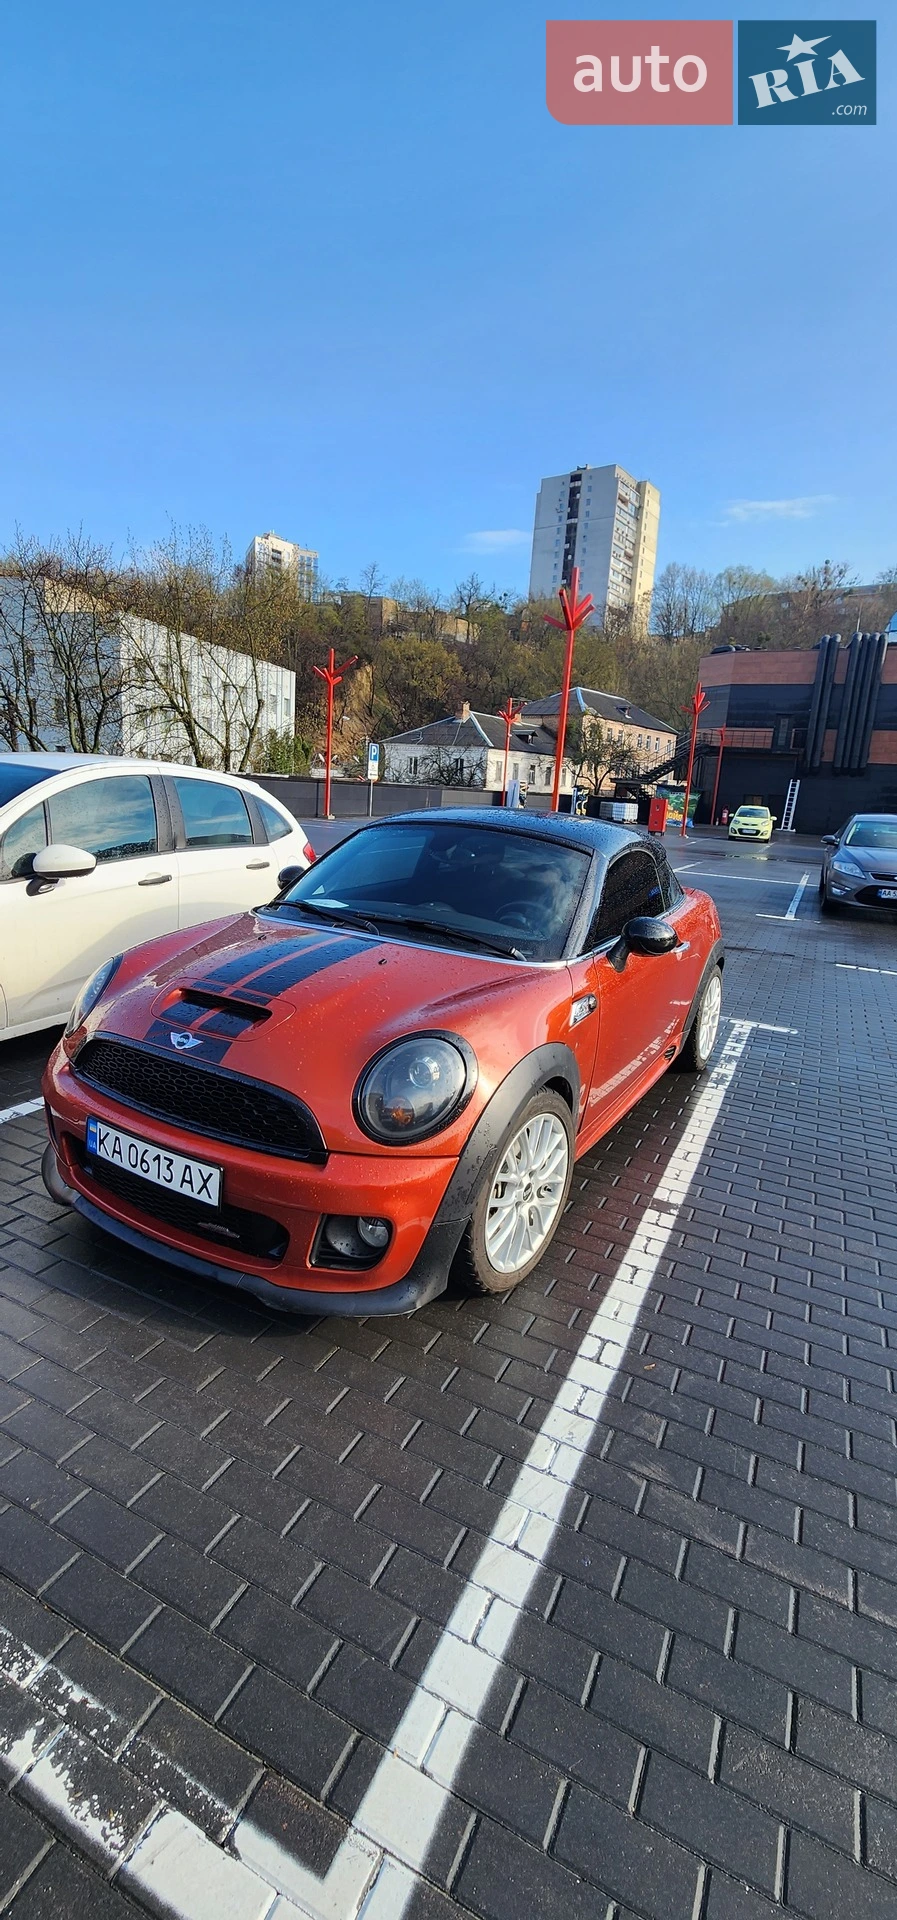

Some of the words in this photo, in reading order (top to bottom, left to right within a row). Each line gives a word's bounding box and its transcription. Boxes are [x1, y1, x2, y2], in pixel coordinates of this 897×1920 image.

[371, 745, 378, 760] P
[98, 1127, 123, 1163] KA
[128, 1143, 173, 1183] 0613
[180, 1164, 213, 1199] AX
